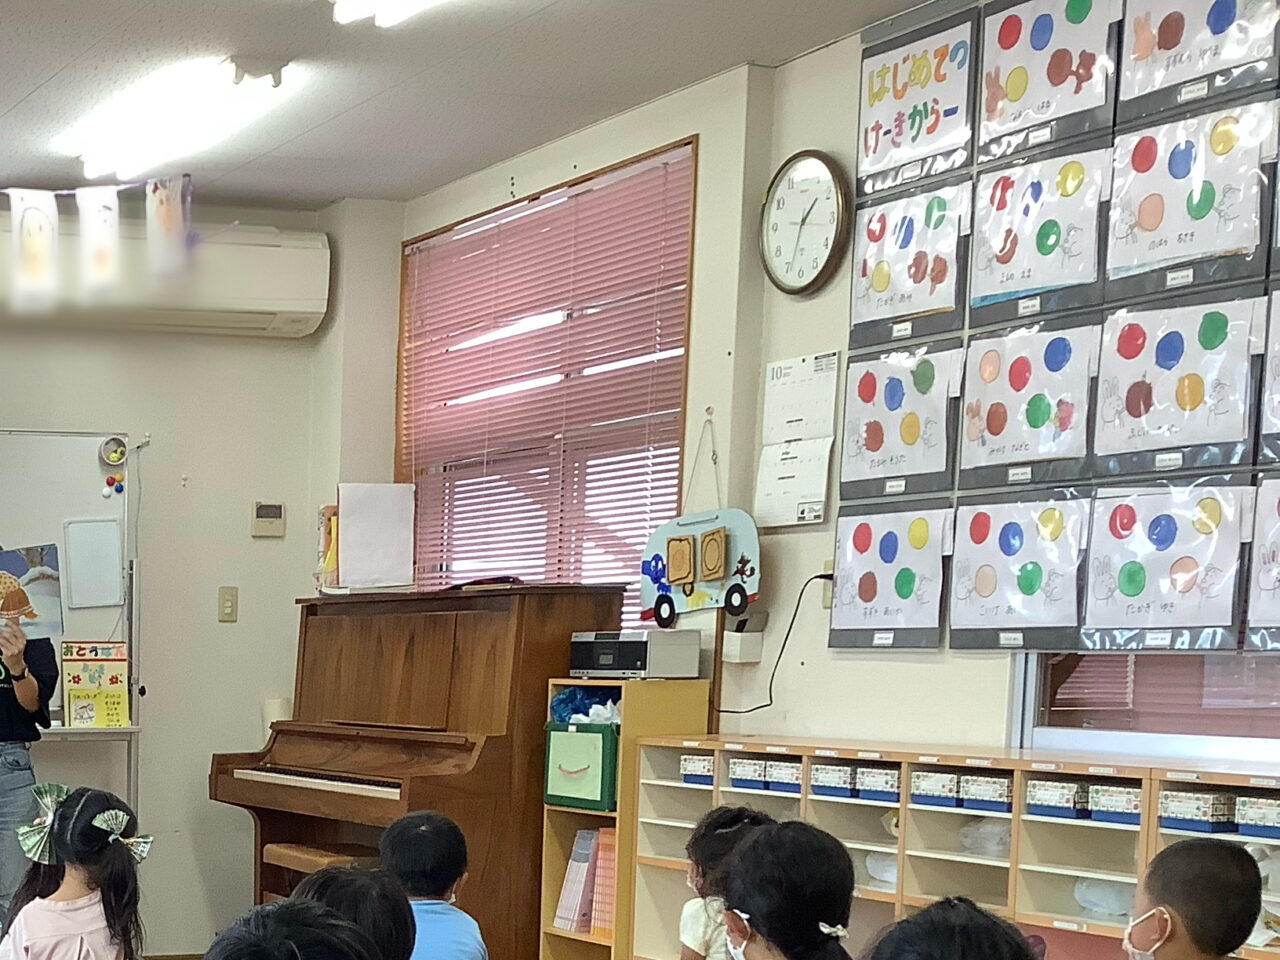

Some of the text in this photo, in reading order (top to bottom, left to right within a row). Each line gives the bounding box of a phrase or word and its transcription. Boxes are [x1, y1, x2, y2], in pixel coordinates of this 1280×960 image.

[864, 98, 959, 158] けーきからー
[825, 186, 832, 200] 2
[776, 196, 785, 211] 10
[829, 211, 835, 225] 3
[772, 222, 778, 234] 9
[823, 237, 829, 250] 4
[775, 246, 782, 258] 8
[785, 261, 791, 274] 7
[812, 257, 818, 270] 5
[797, 268, 804, 279] 6
[771, 366, 783, 381] 10
